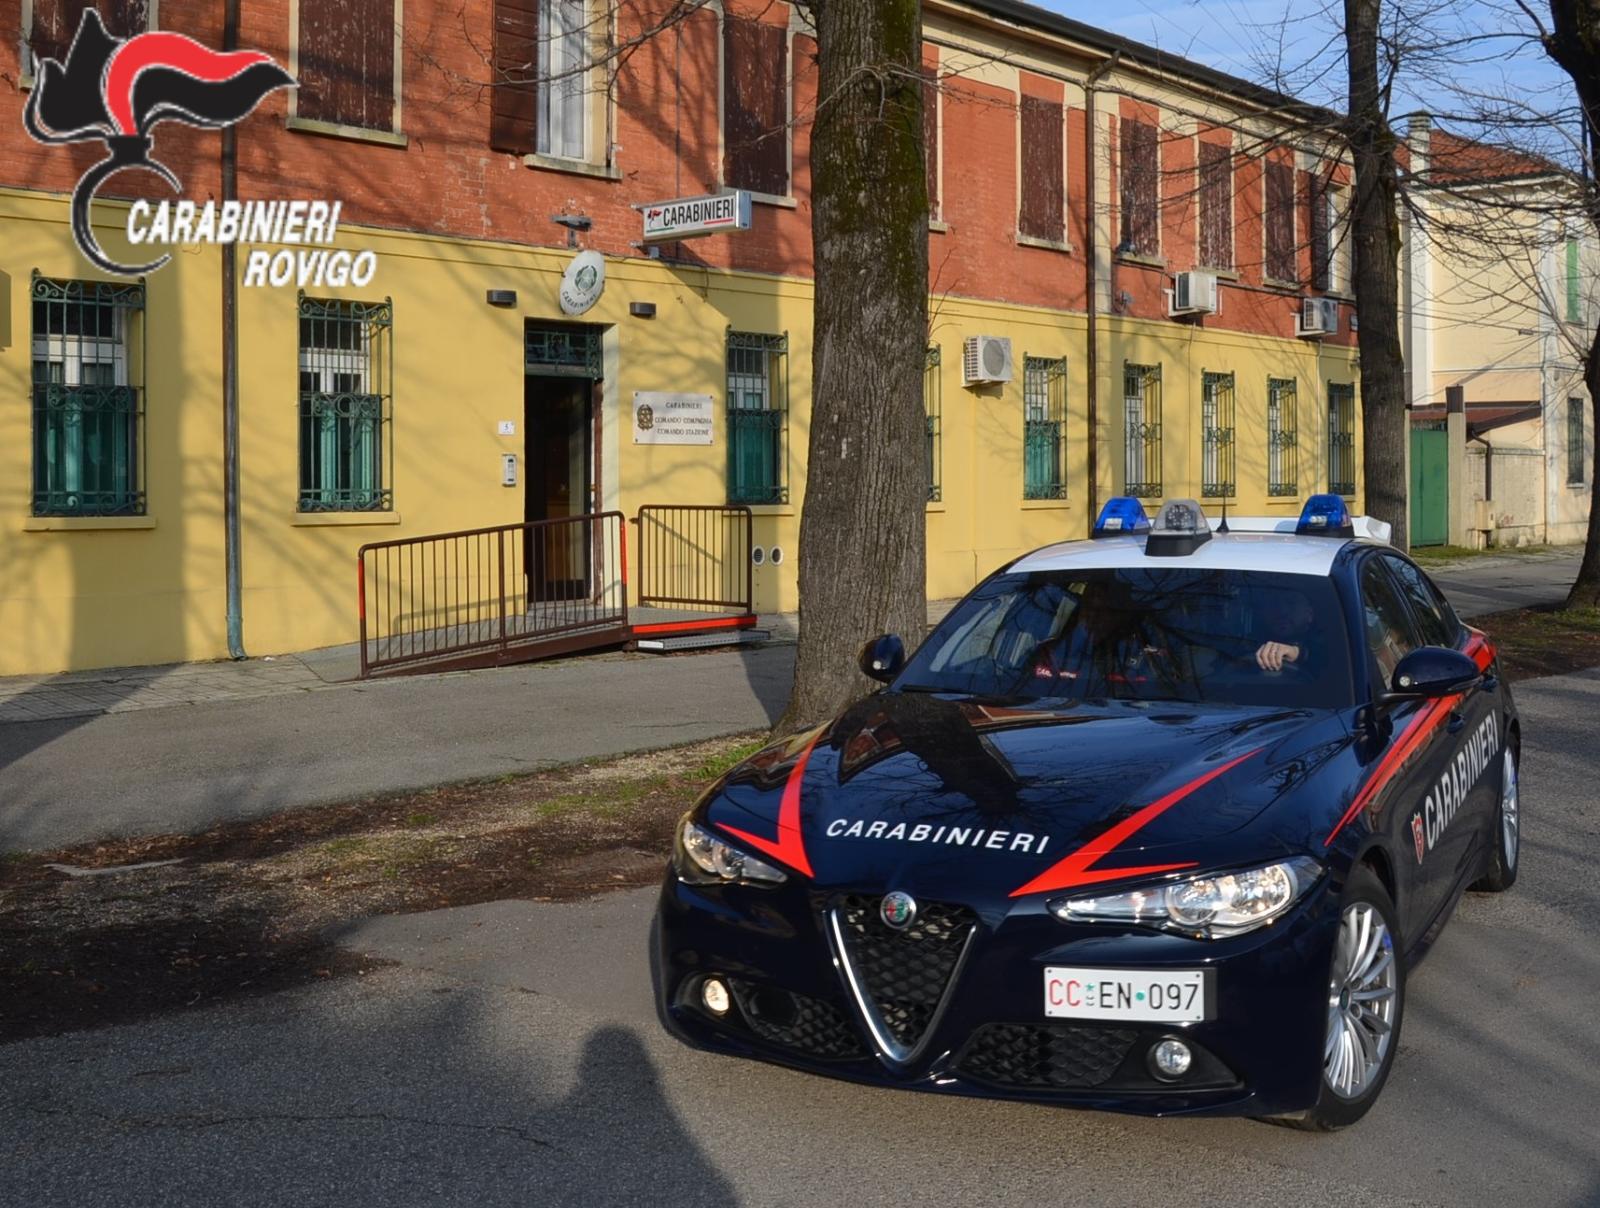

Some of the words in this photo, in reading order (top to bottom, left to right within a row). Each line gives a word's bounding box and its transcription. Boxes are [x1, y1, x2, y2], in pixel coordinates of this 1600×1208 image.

[663, 198, 734, 227] CARABINIERI
[655, 416, 682, 424] COMANDO
[1425, 709, 1499, 850] CARABINIERI
[826, 818, 1050, 854] CARABINIERI
[1050, 979, 1081, 1007] CC
[1100, 981, 1132, 1009] EN
[1149, 983, 1199, 1010] 097
